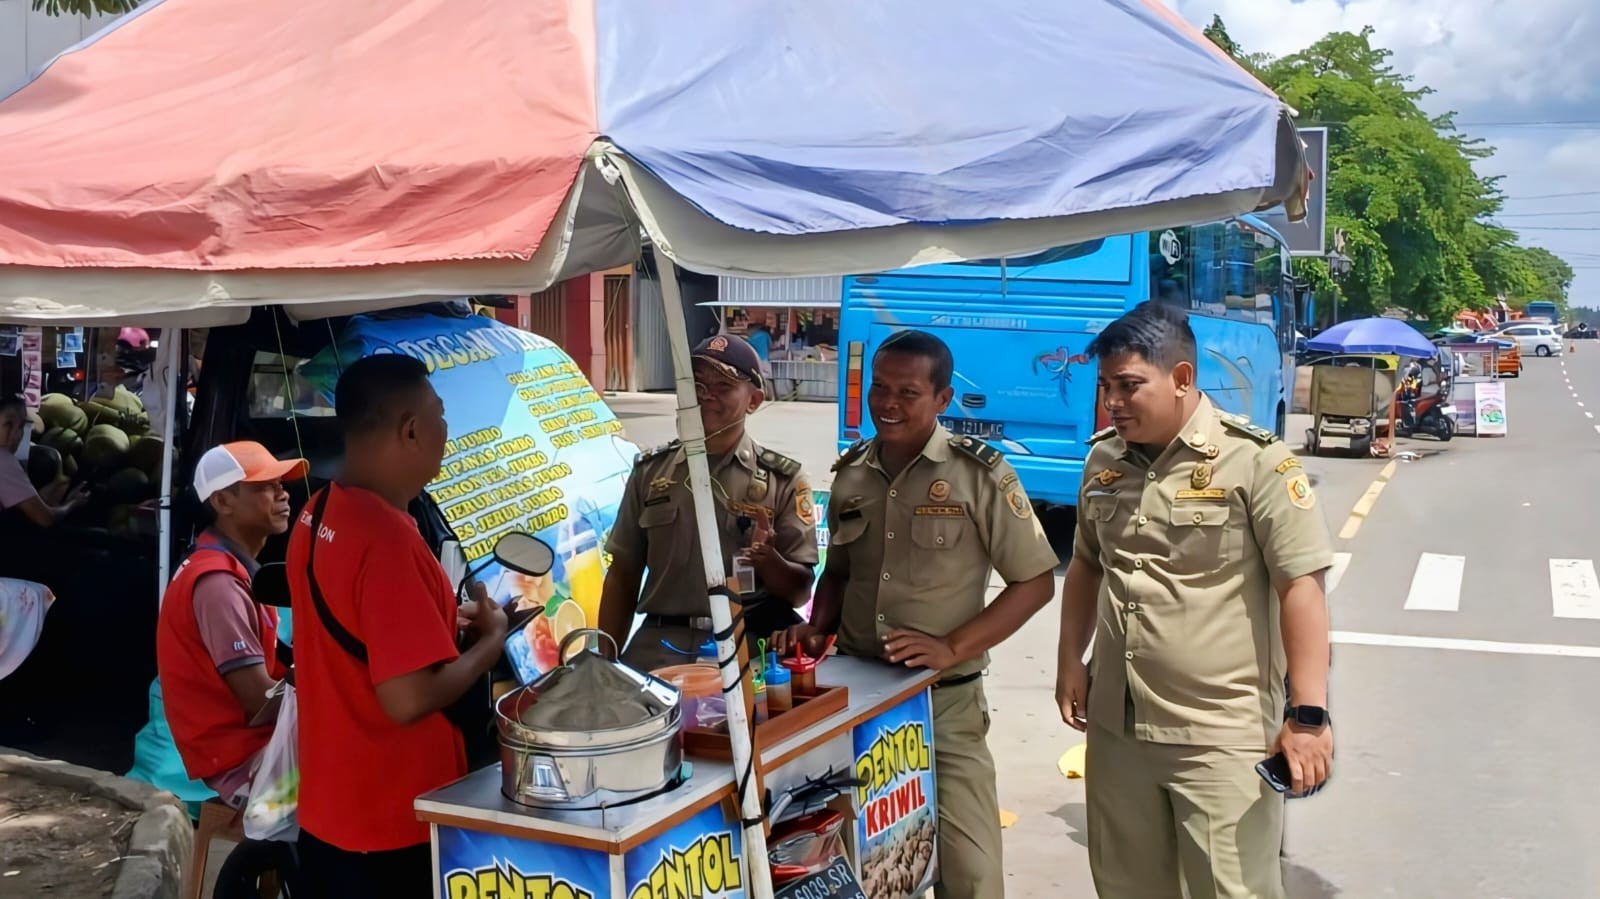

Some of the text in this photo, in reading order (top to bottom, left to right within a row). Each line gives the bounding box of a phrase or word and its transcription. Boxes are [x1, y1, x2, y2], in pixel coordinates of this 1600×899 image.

[396, 331, 495, 374] DEGAN
[448, 447, 497, 476] PANAS
[494, 435, 535, 459] JUMBO
[456, 426, 502, 451] JUMBO
[430, 452, 548, 502] LEMON TEA JUMBO
[445, 463, 572, 522] JERUK PANAS JUMBO
[454, 522, 476, 541] ES
[476, 503, 524, 533] JERUK
[521, 487, 564, 512] JUMBO
[526, 504, 569, 535] JUMBO
[856, 723, 930, 810] PENTOL
[865, 776, 926, 838] KRIWIL
[630, 834, 742, 899] ENTOL
[827, 863, 853, 889] SR
